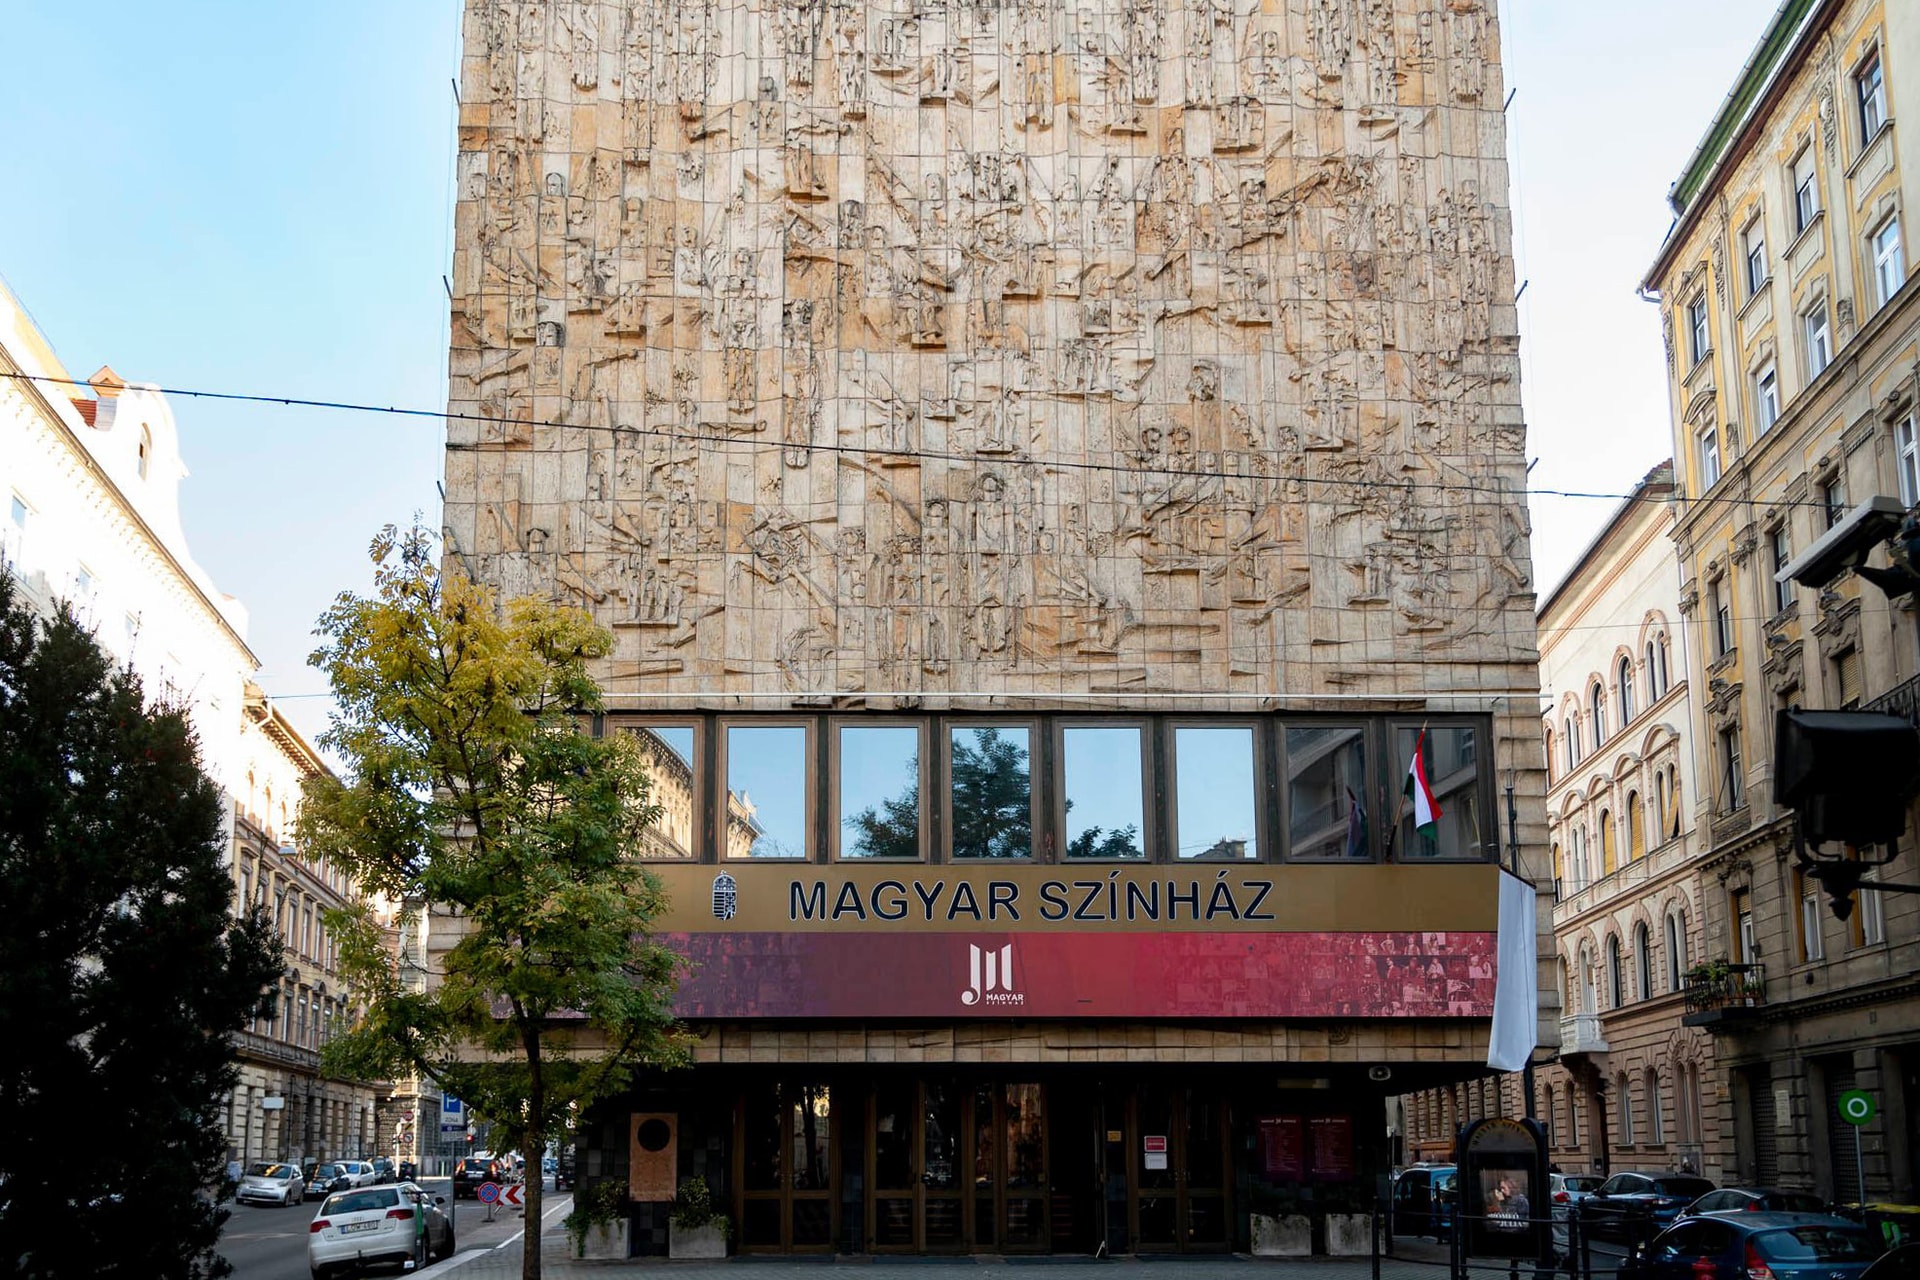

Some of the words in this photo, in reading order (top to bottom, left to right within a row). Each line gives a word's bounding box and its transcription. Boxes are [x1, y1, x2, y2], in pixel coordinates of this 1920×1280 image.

[788, 880, 1021, 922] MAGYAR
[1037, 869, 1276, 922] SZÍNHÁZ
[985, 993, 1024, 1001] MAGYAR
